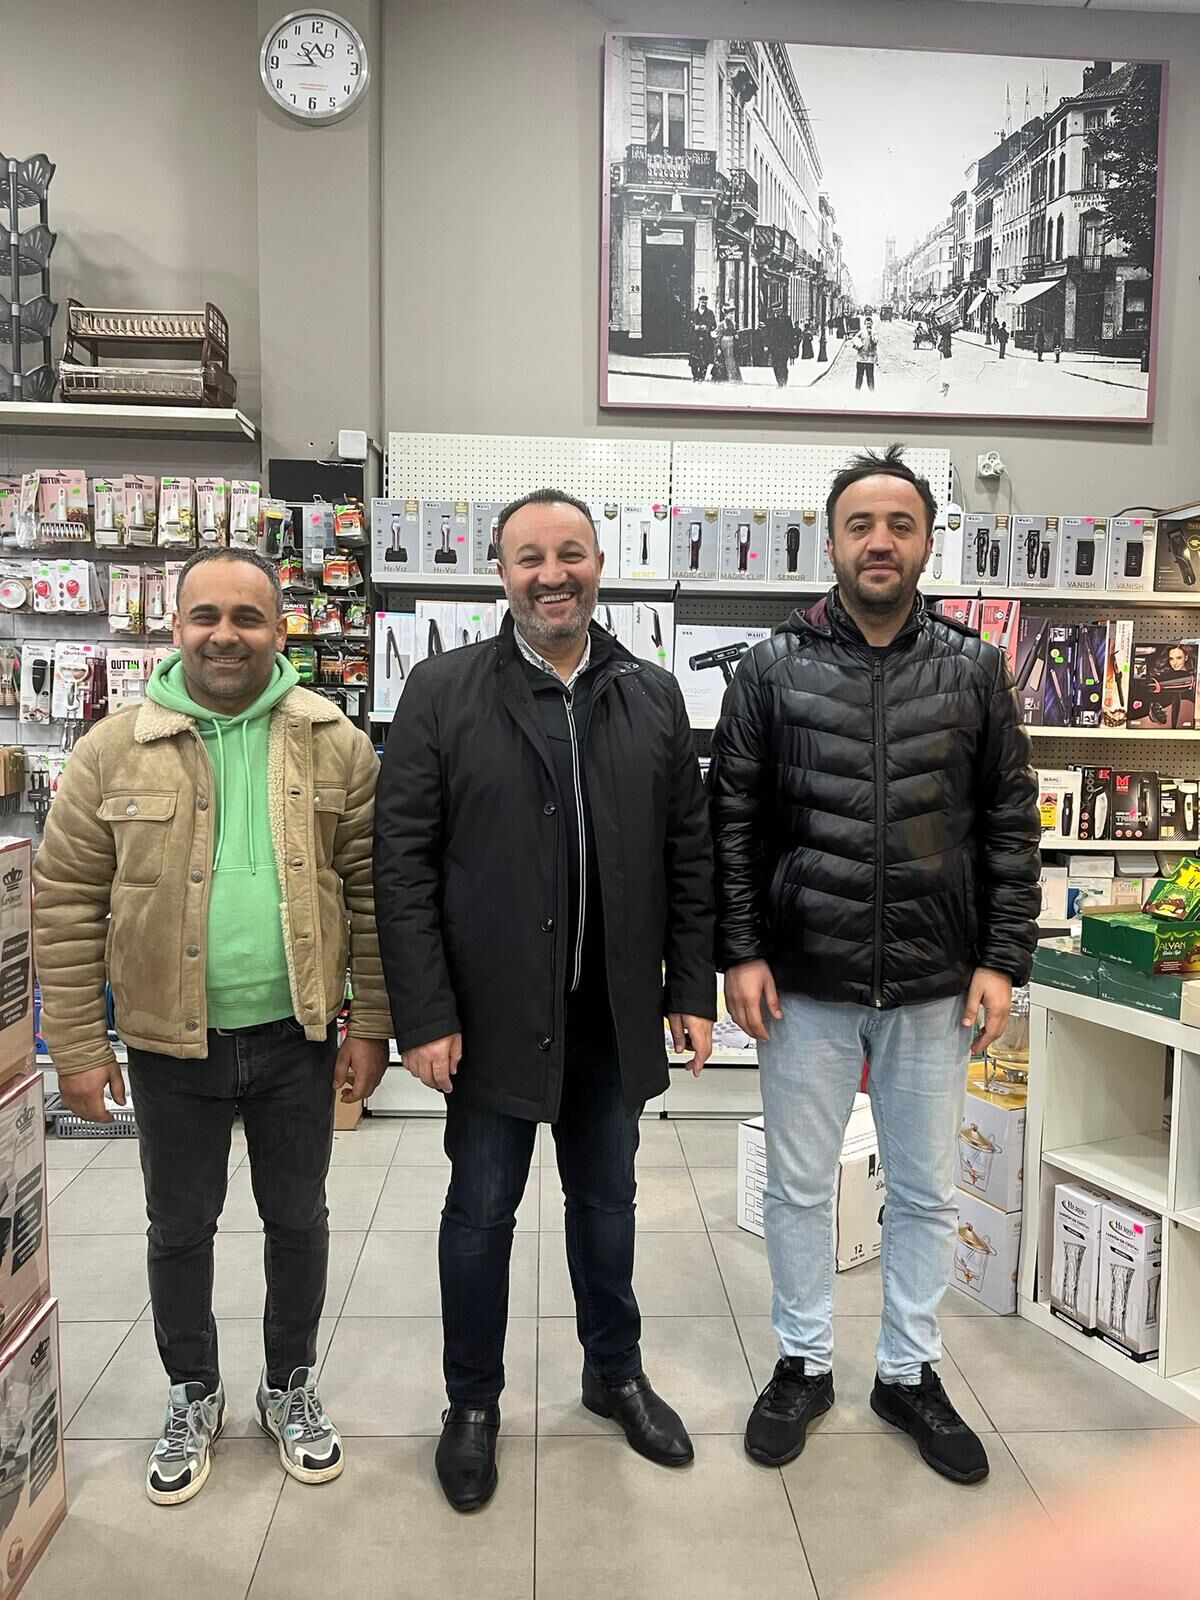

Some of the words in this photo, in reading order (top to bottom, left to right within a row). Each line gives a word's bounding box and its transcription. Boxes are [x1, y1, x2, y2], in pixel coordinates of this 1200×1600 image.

[294, 25, 301, 35] 11
[312, 21, 324, 34] 12
[334, 28, 338, 39] 1
[278, 39, 288, 49] 10
[347, 44, 354, 54] 2
[297, 41, 335, 59] SAB
[270, 55, 280, 70] 9
[350, 62, 359, 76] 3
[276, 79, 283, 89] 8
[343, 85, 351, 95] 4
[290, 93, 296, 104] 7
[308, 96, 317, 110] 6
[329, 96, 336, 107] 5
[1067, 581, 1096, 589] VANISH
[111, 659, 139, 670] QUTTIN
[1159, 941, 1186, 950] ALYAN
[854, 1244, 863, 1255] 12
